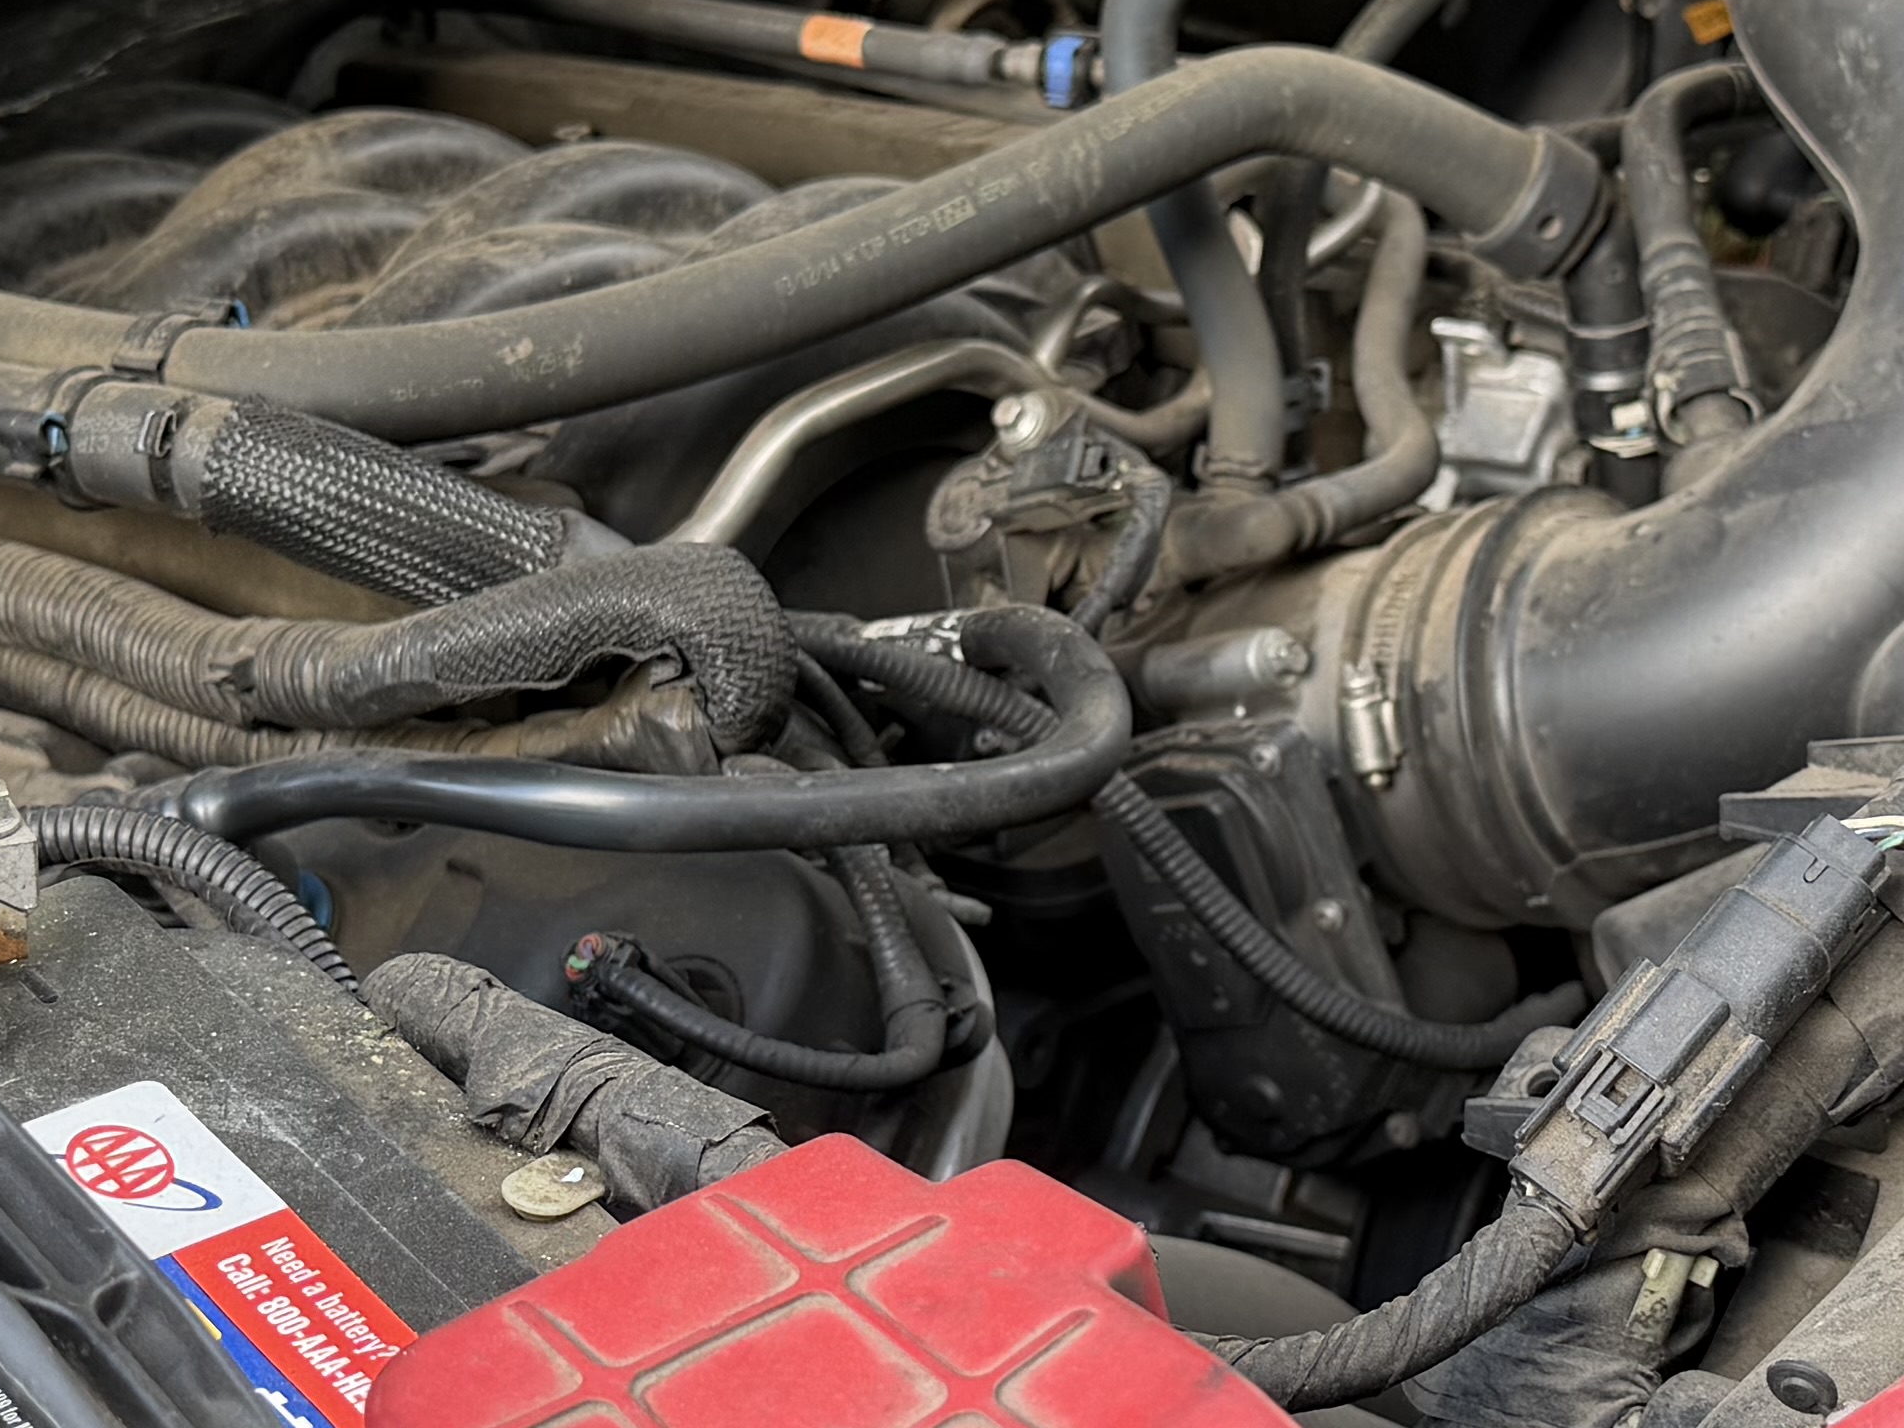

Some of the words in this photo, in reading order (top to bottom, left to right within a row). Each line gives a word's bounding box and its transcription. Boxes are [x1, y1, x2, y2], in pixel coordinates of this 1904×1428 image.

[69, 1126, 175, 1197] AAA
[214, 1252, 277, 1300] Call:
[259, 1236, 321, 1285] Need
[299, 1280, 328, 1297] a
[313, 1291, 399, 1361] battery?
